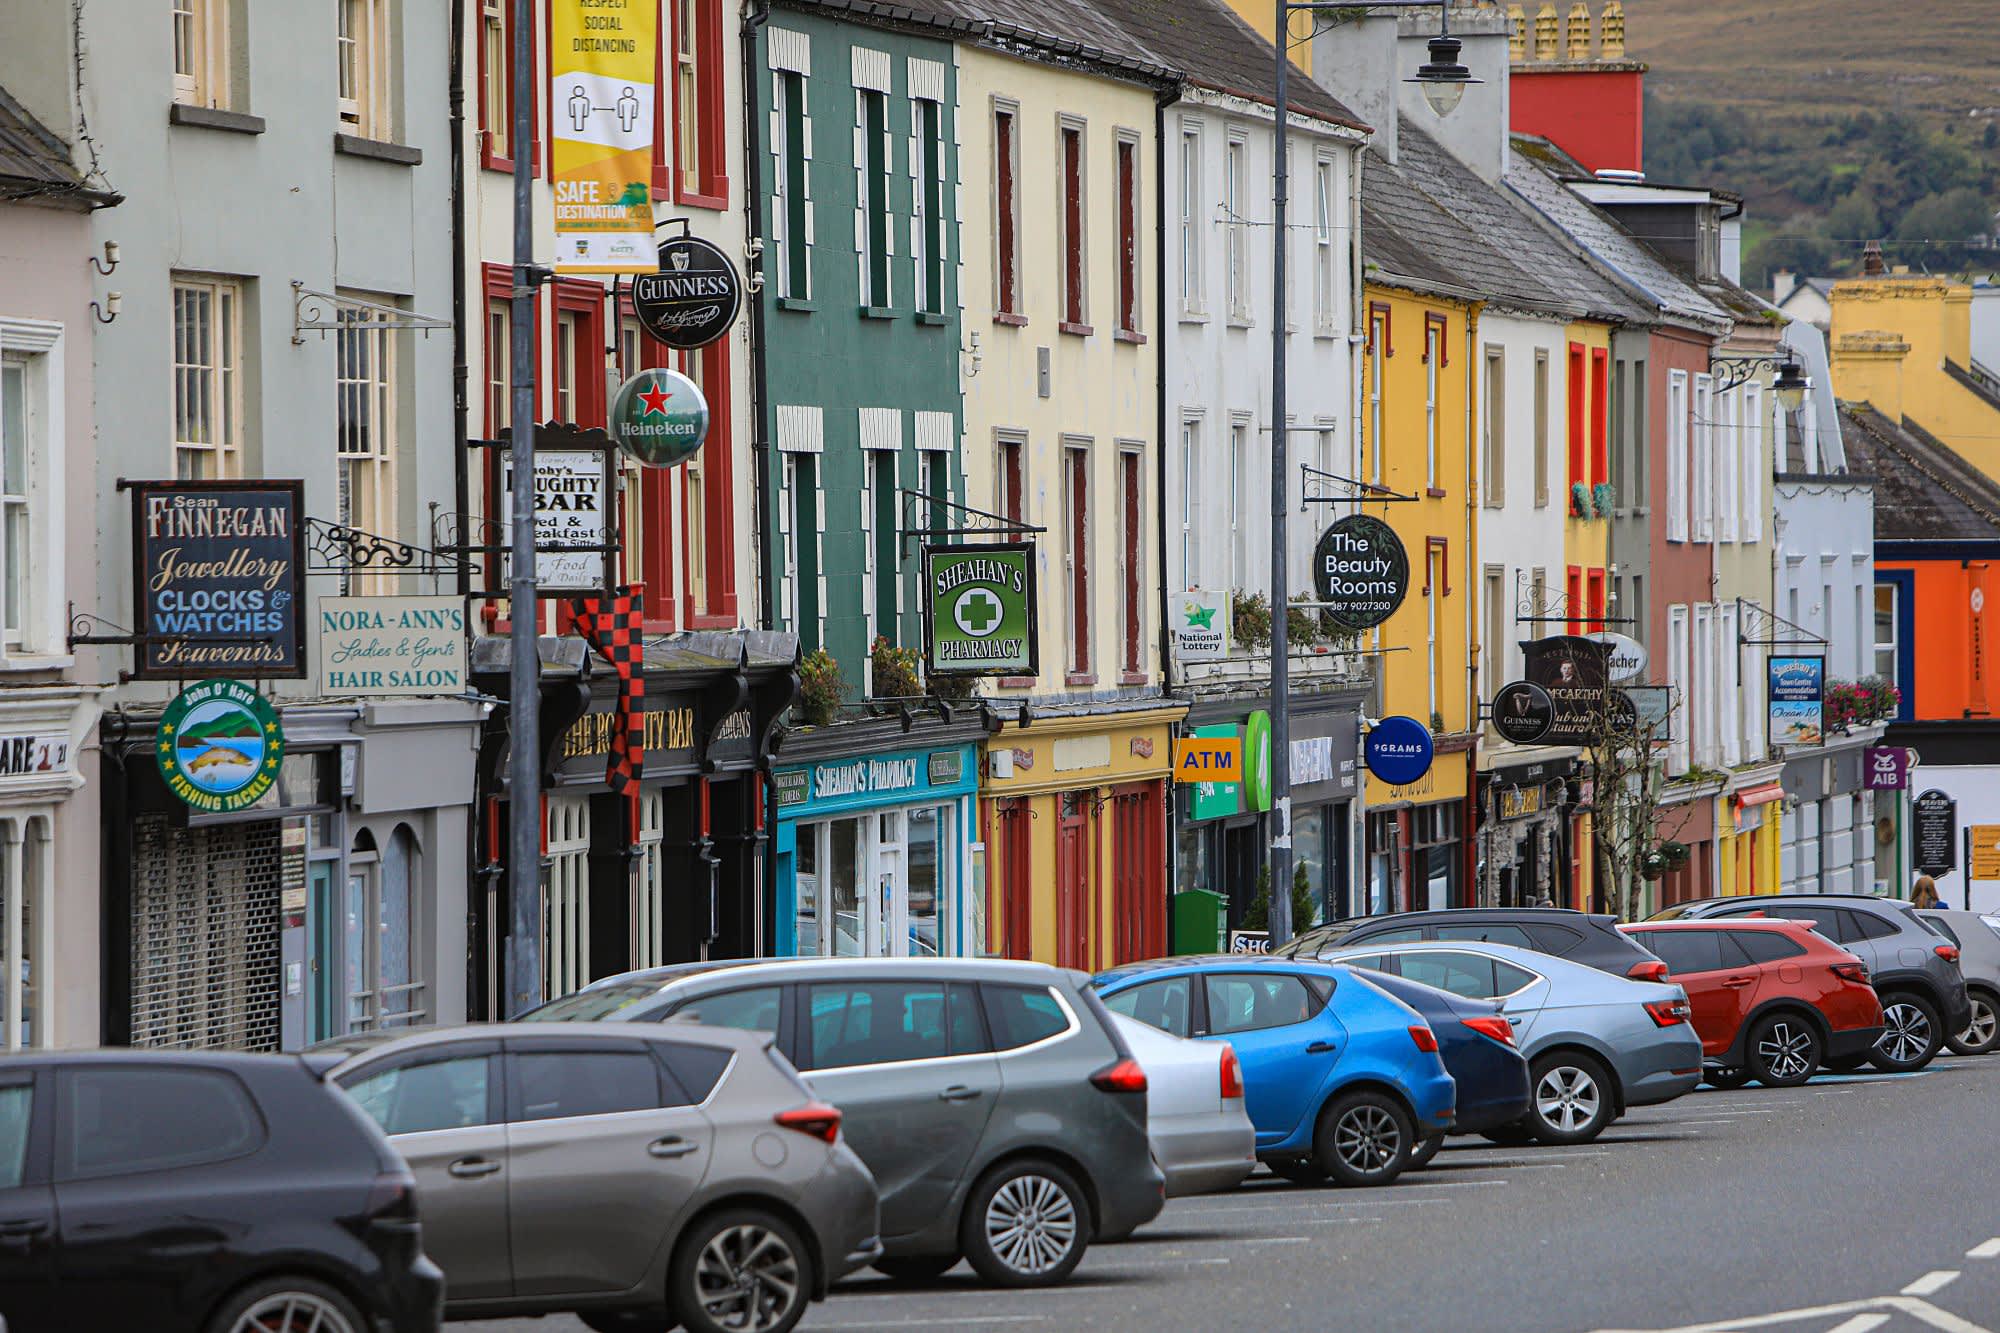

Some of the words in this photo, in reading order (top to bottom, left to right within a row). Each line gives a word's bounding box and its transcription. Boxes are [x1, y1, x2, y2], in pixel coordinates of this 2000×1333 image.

[584, 16, 623, 30] SOCIAL
[573, 38, 635, 53] DISTANCING
[557, 181, 600, 202] SAFE
[556, 205, 626, 219] DESTINATION
[639, 276, 729, 300] GUINNESS
[619, 422, 696, 436] Heineken
[174, 496, 219, 508] Sean
[534, 494, 599, 512] BAR
[148, 497, 288, 538] FINNEGAN
[535, 517, 557, 527] ed
[567, 516, 583, 527] &
[535, 528, 596, 539] eakfast
[1332, 533, 1369, 551] The
[151, 547, 289, 592] Jewellery
[551, 554, 592, 571] Food
[1325, 555, 1392, 577] Beauty
[1330, 577, 1397, 594] Rooms
[157, 590, 265, 612] CLOCKS
[271, 590, 292, 610] &
[1350, 601, 1391, 611] 9027300
[154, 612, 284, 633] WATCHES
[1179, 633, 1222, 642] National
[157, 635, 285, 664] Souvenirs
[331, 637, 392, 664] Ladies
[396, 637, 409, 656] &
[940, 639, 1022, 660] PHARMACY
[1183, 642, 1220, 652] Lottery
[328, 671, 384, 688] HAIR
[388, 669, 459, 688] SALON
[184, 685, 212, 706] John
[228, 684, 256, 705] Hare
[1504, 716, 1542, 725] GUINNESS
[1555, 711, 1570, 722] ub
[1772, 706, 1803, 718] Ocean
[1804, 706, 1820, 717] 10
[668, 707, 695, 750] BAR
[0, 736, 36, 774] ARE
[1183, 751, 1232, 769] ATM
[814, 760, 866, 798] SHEAHAN'S
[868, 758, 917, 792] PHARMACY
[1872, 773, 1898, 786] AIB
[169, 773, 222, 811] FISHING
[224, 772, 272, 810] TACKLE
